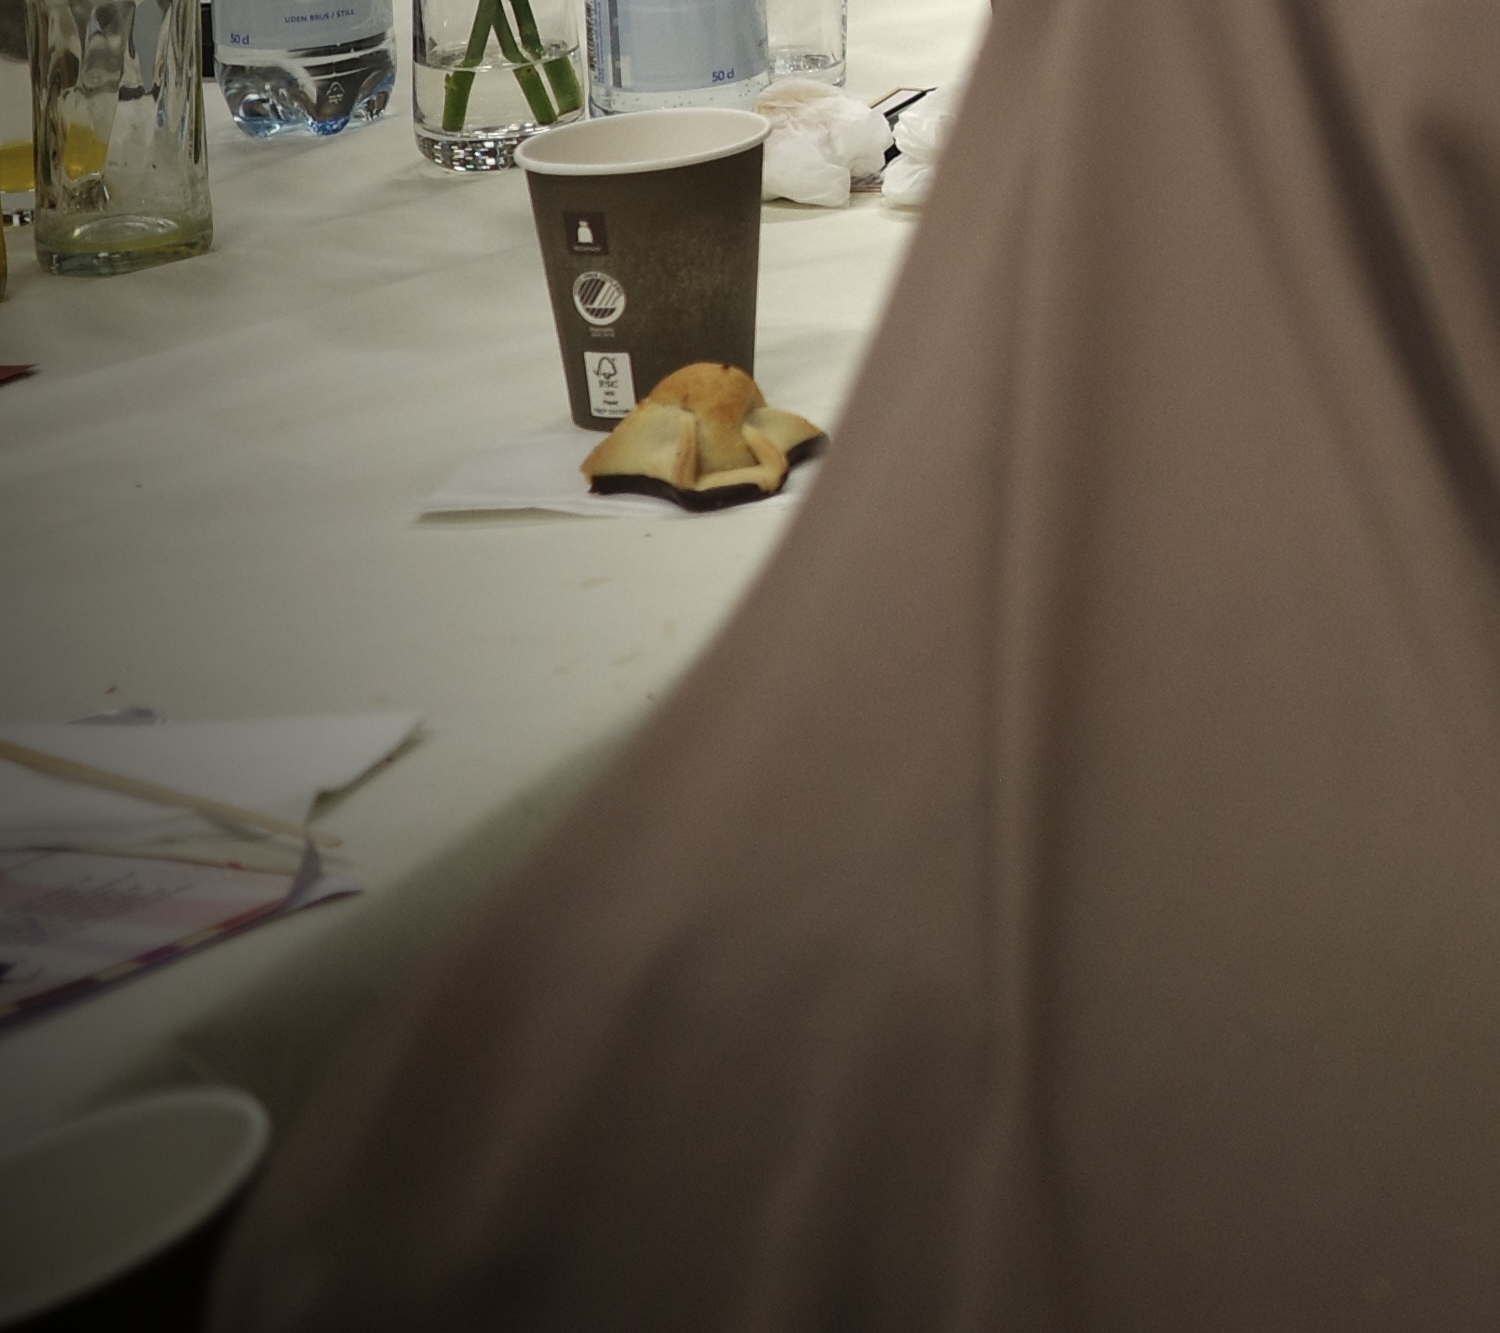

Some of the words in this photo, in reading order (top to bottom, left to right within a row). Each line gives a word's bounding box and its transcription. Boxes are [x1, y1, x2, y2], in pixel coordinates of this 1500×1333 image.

[284, 14, 308, 24] UDEN
[309, 12, 330, 22] BRUS
[336, 9, 355, 18] STILL
[230, 33, 241, 44] 50
[242, 34, 250, 45] cl
[711, 69, 725, 83] 50
[726, 68, 735, 80] cl
